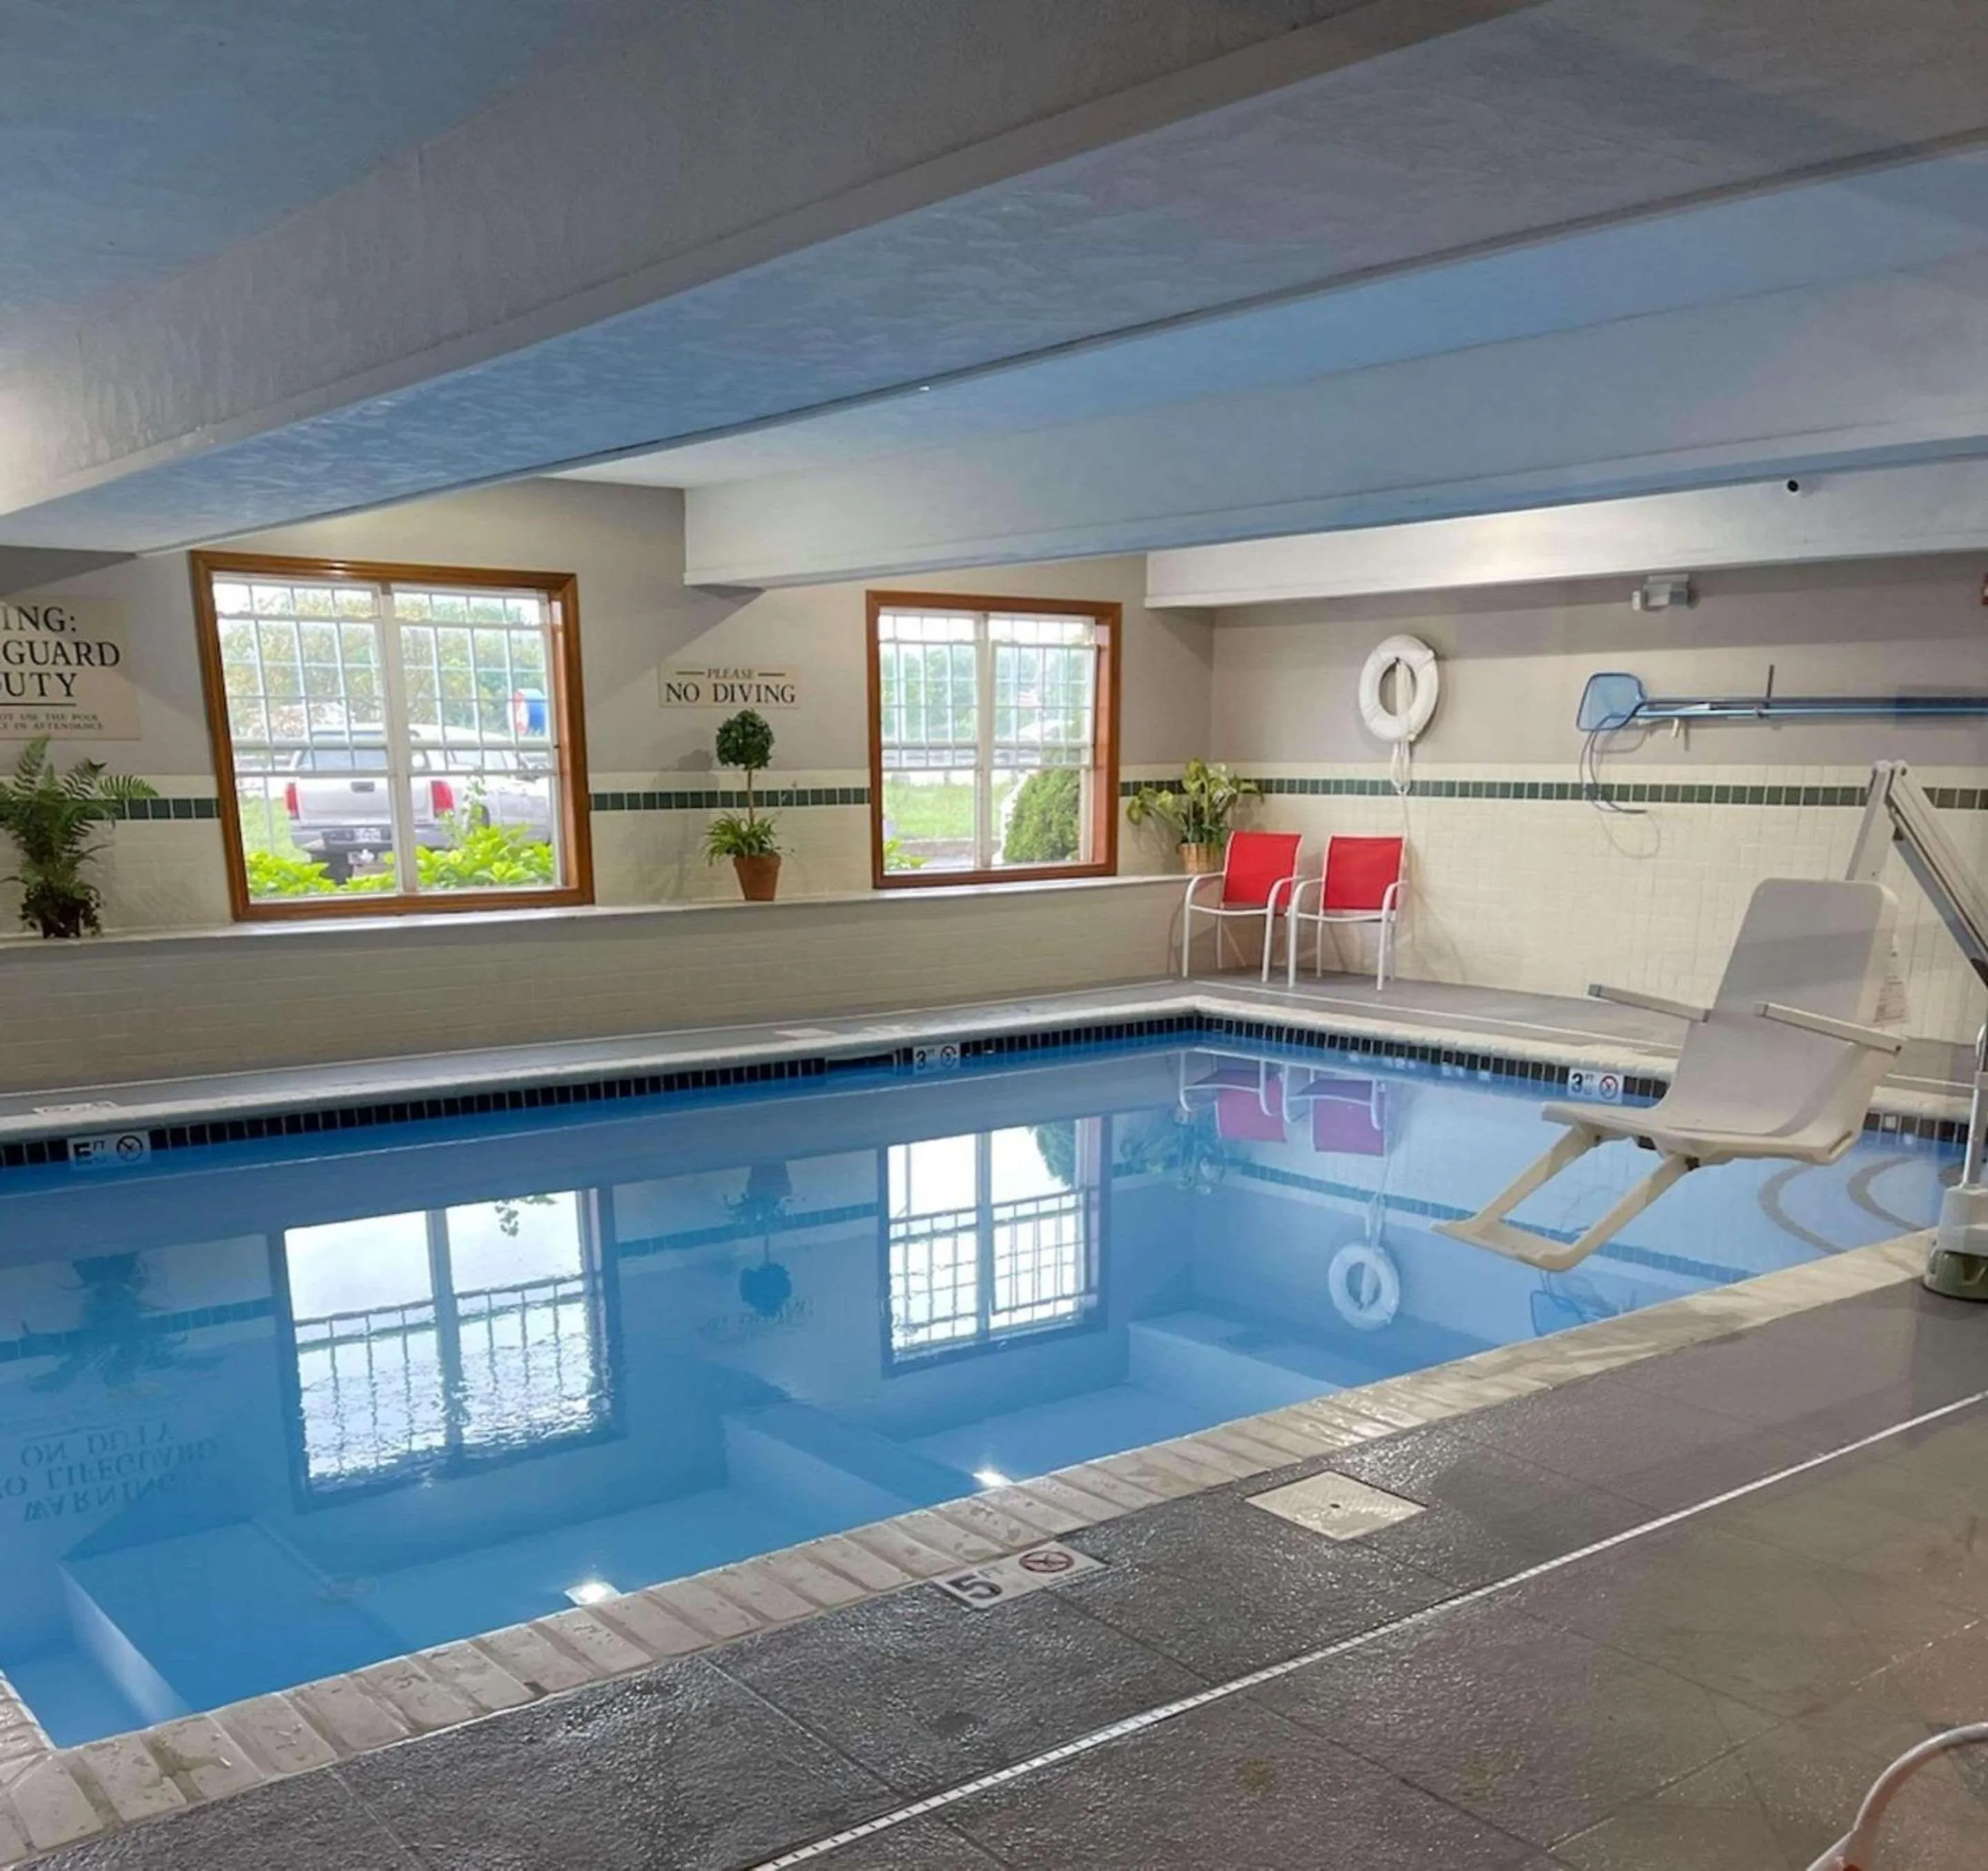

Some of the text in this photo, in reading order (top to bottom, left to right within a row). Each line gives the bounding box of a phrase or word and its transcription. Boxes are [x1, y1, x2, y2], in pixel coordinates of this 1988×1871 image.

[2, 639, 121, 667] GUARD
[0, 672, 77, 697] UTY
[707, 668, 754, 680] PLEASE
[665, 682, 796, 704] NO DIVING
[946, 1574, 1002, 1599] 5
